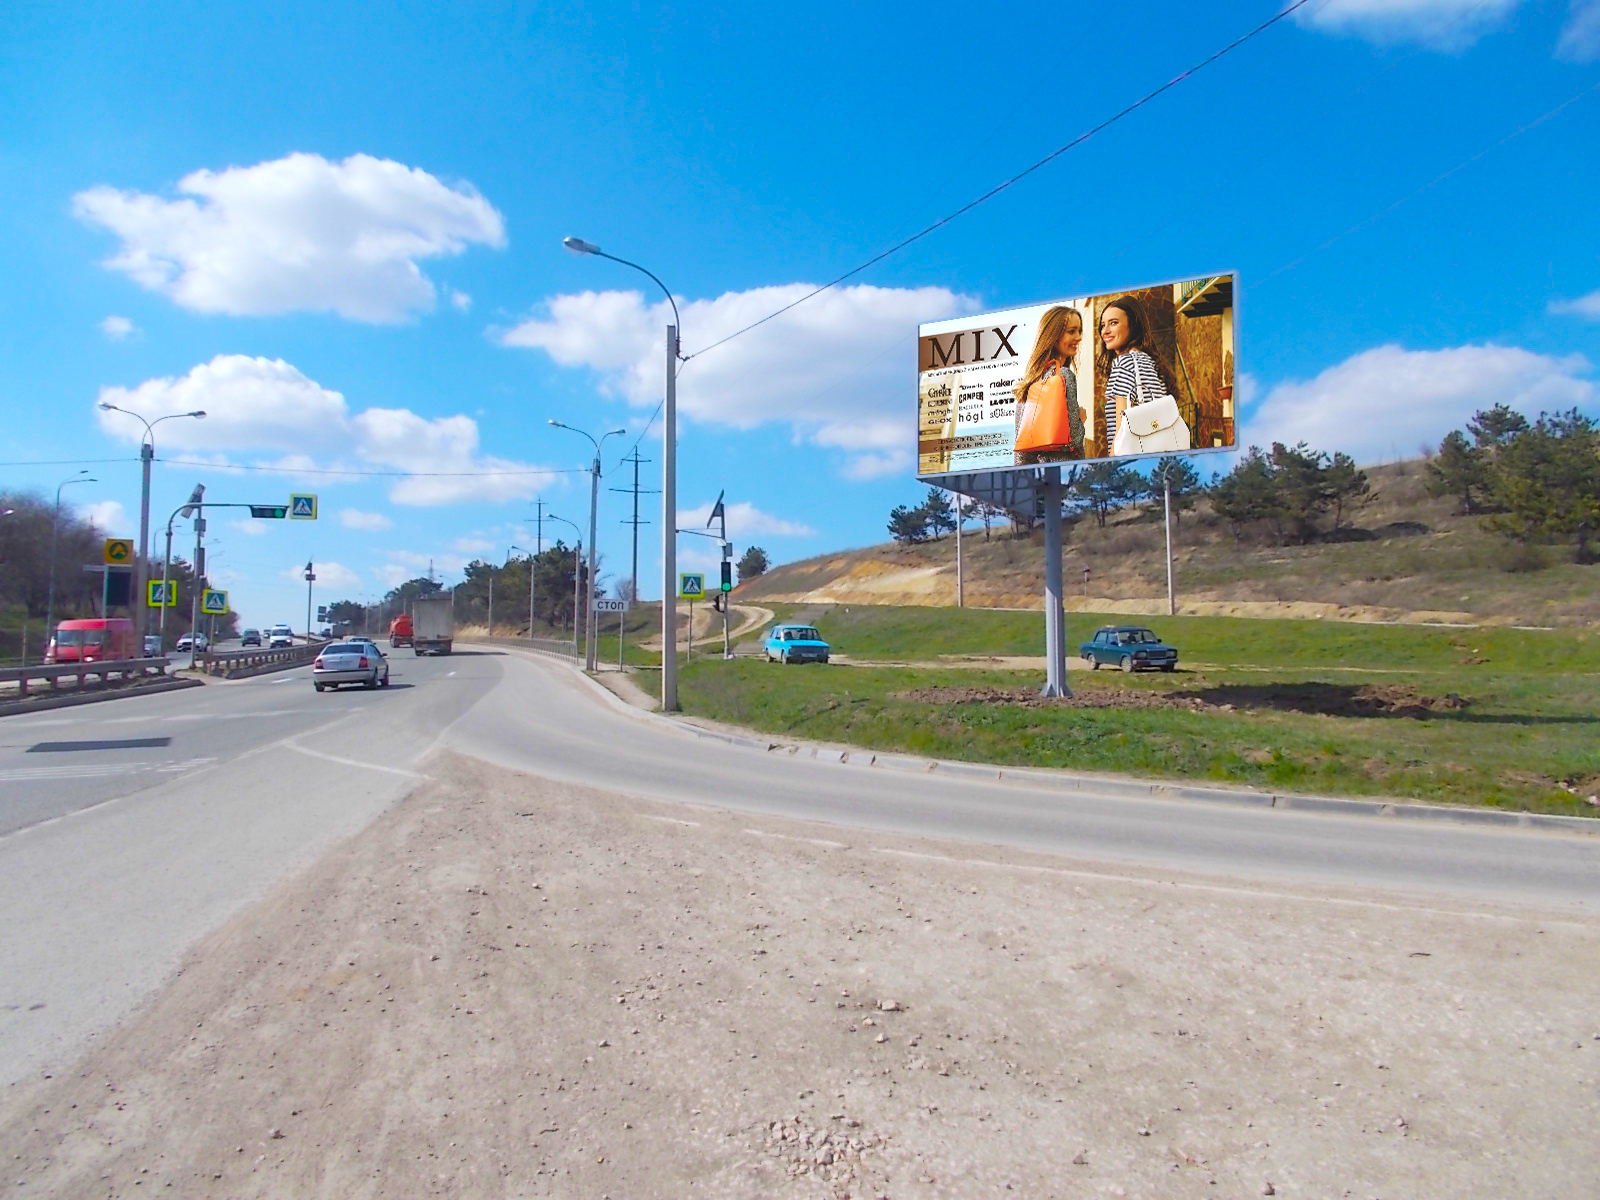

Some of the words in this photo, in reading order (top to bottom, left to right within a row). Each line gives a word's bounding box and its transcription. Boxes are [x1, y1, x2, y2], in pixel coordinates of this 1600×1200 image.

[928, 324, 1018, 368] MIX
[958, 391, 984, 403] CAMPER
[989, 397, 1015, 406] LLOYD
[958, 411, 984, 424] högl
[597, 601, 624, 610] СТОП
